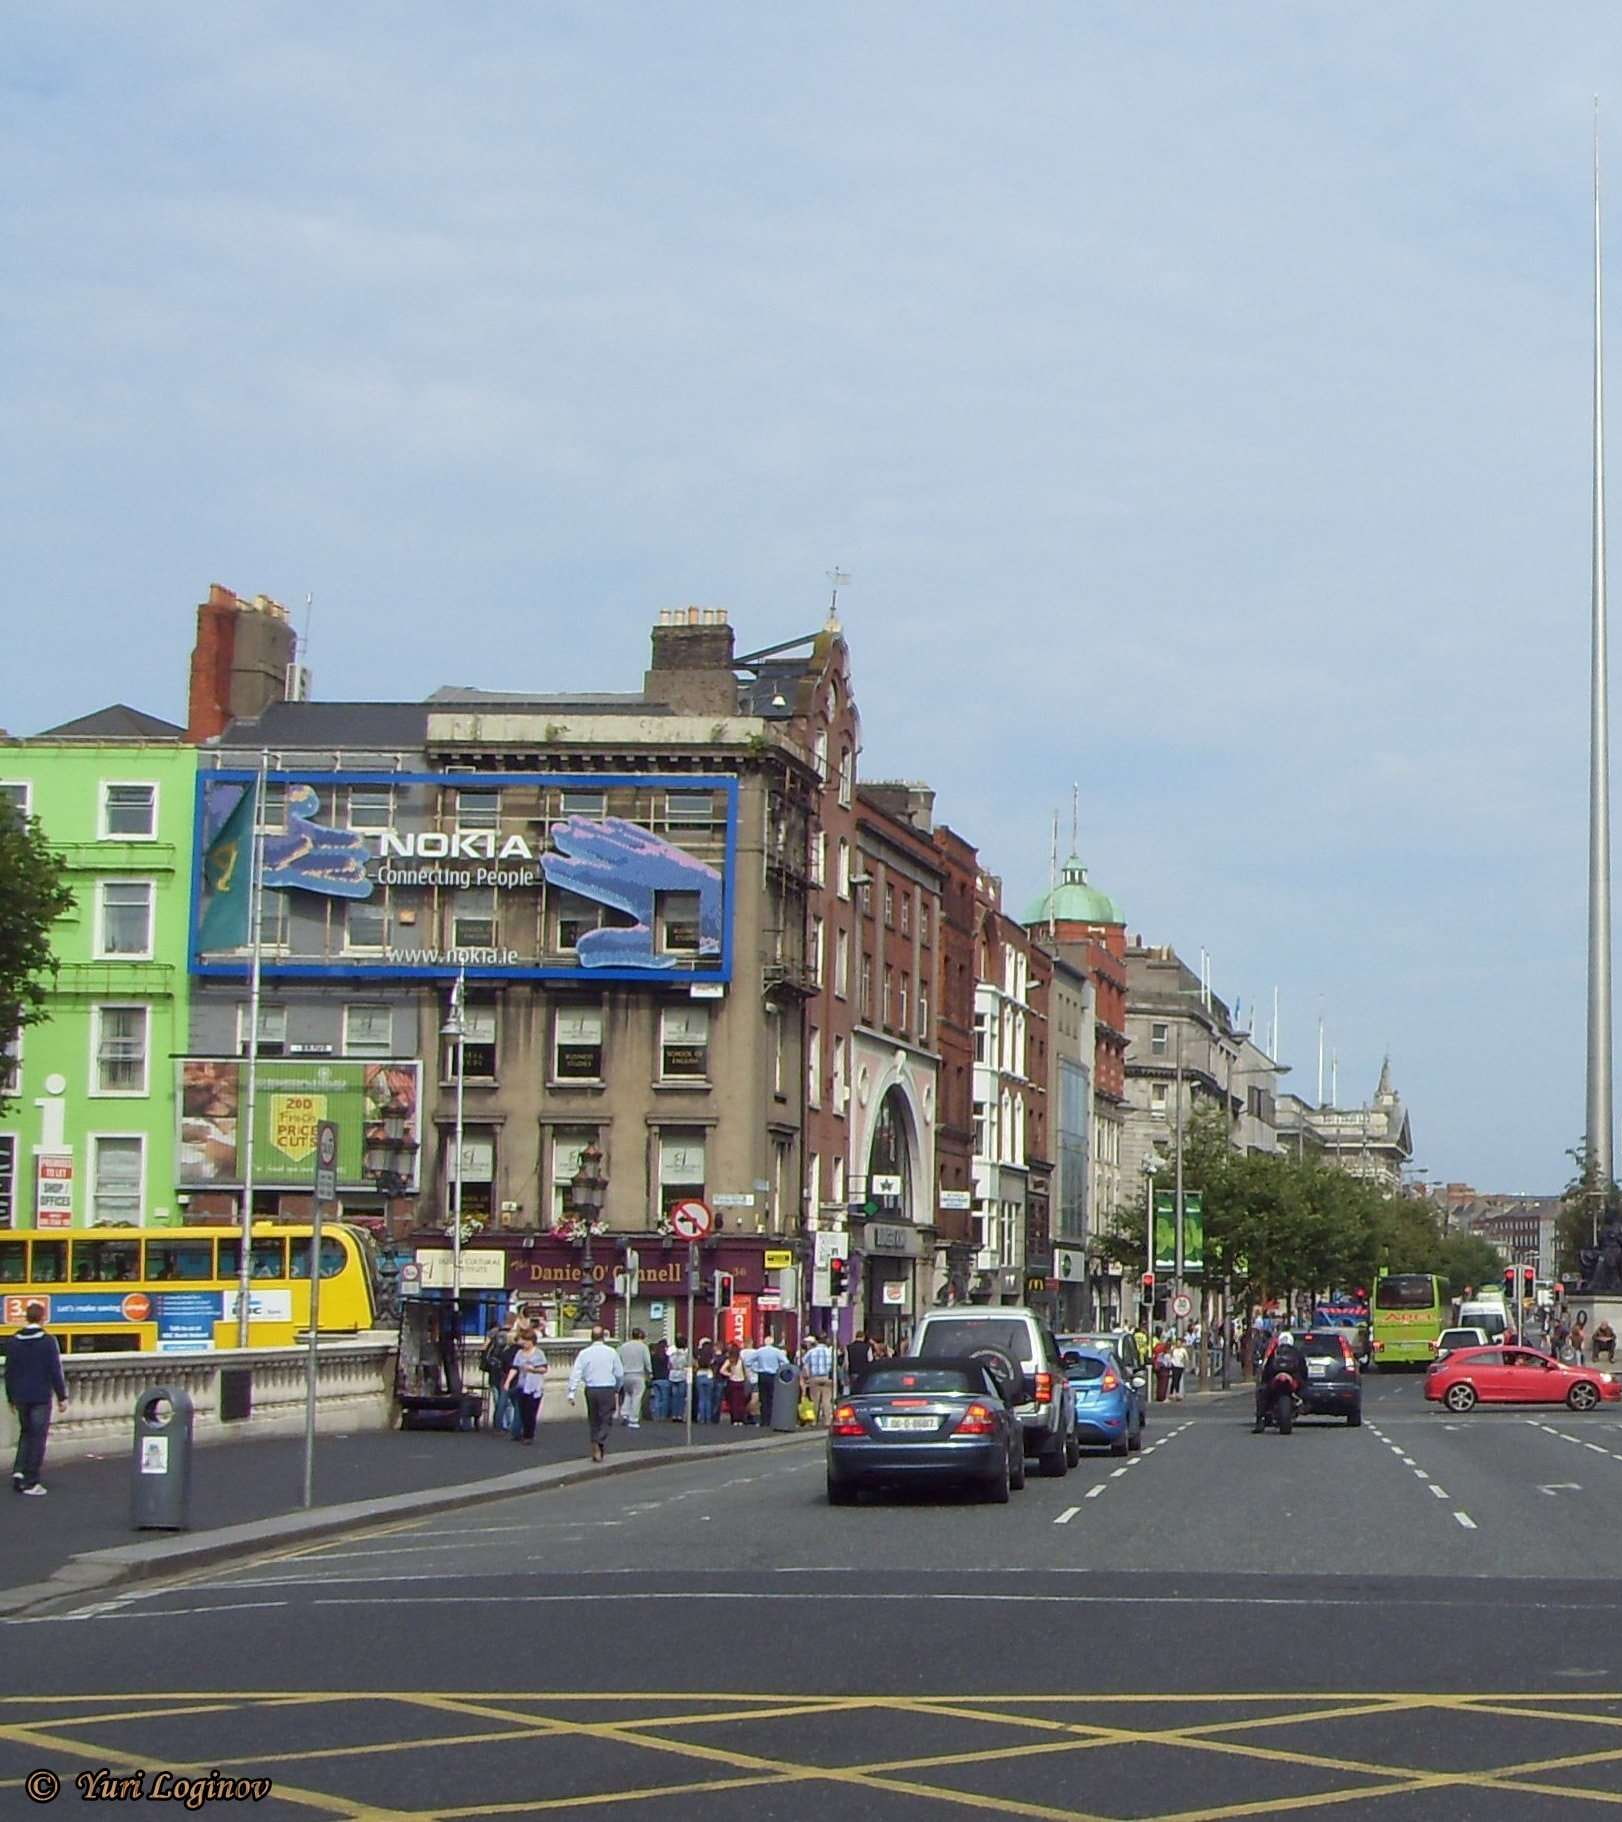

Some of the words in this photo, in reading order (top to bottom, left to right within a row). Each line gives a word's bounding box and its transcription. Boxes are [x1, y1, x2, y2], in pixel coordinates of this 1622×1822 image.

[380, 832, 533, 859] NOKIA
[378, 866, 470, 889] Connecting
[477, 867, 534, 890] People
[387, 947, 518, 965] www.nokia.ie
[277, 1125, 319, 1136] PRICE
[277, 1136, 319, 1148] CUTS
[531, 1263, 586, 1281] Danie
